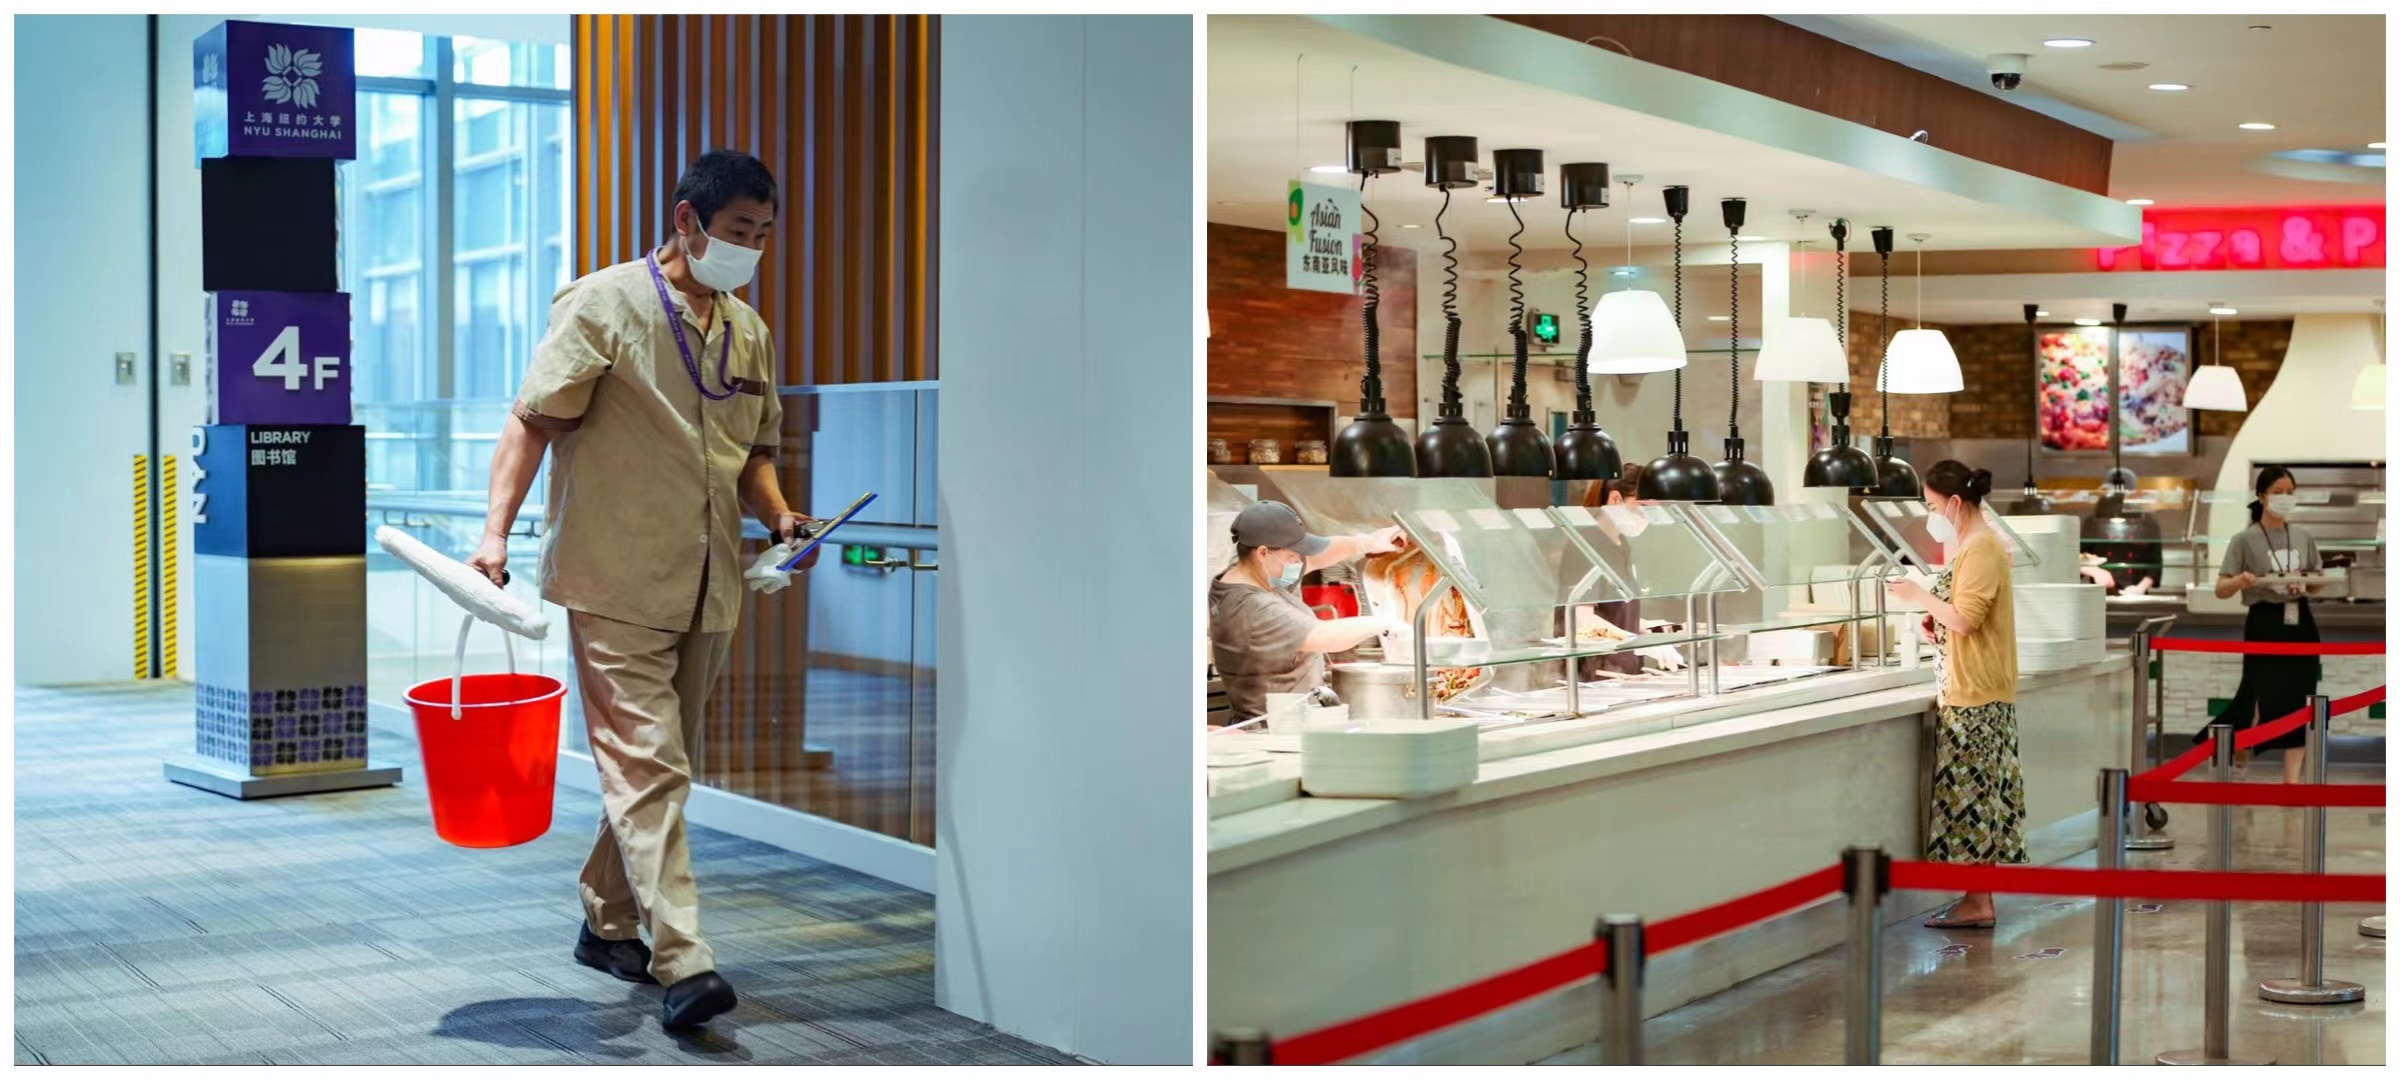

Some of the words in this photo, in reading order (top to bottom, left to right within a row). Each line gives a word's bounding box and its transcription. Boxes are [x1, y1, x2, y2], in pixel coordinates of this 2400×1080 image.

[244, 111, 341, 127] 上海纽约大学
[244, 126, 270, 136] NYU
[275, 127, 341, 139] SHANGHAI
[1310, 202, 1341, 229] Asian
[1309, 229, 1342, 256] Fusion
[2280, 216, 2325, 264] &
[2342, 217, 2377, 264] P
[1303, 254, 1348, 275] 东南亚风味
[252, 325, 341, 391] 4F
[250, 431, 311, 444] LIBRARY
[251, 449, 297, 466] 图书馆
